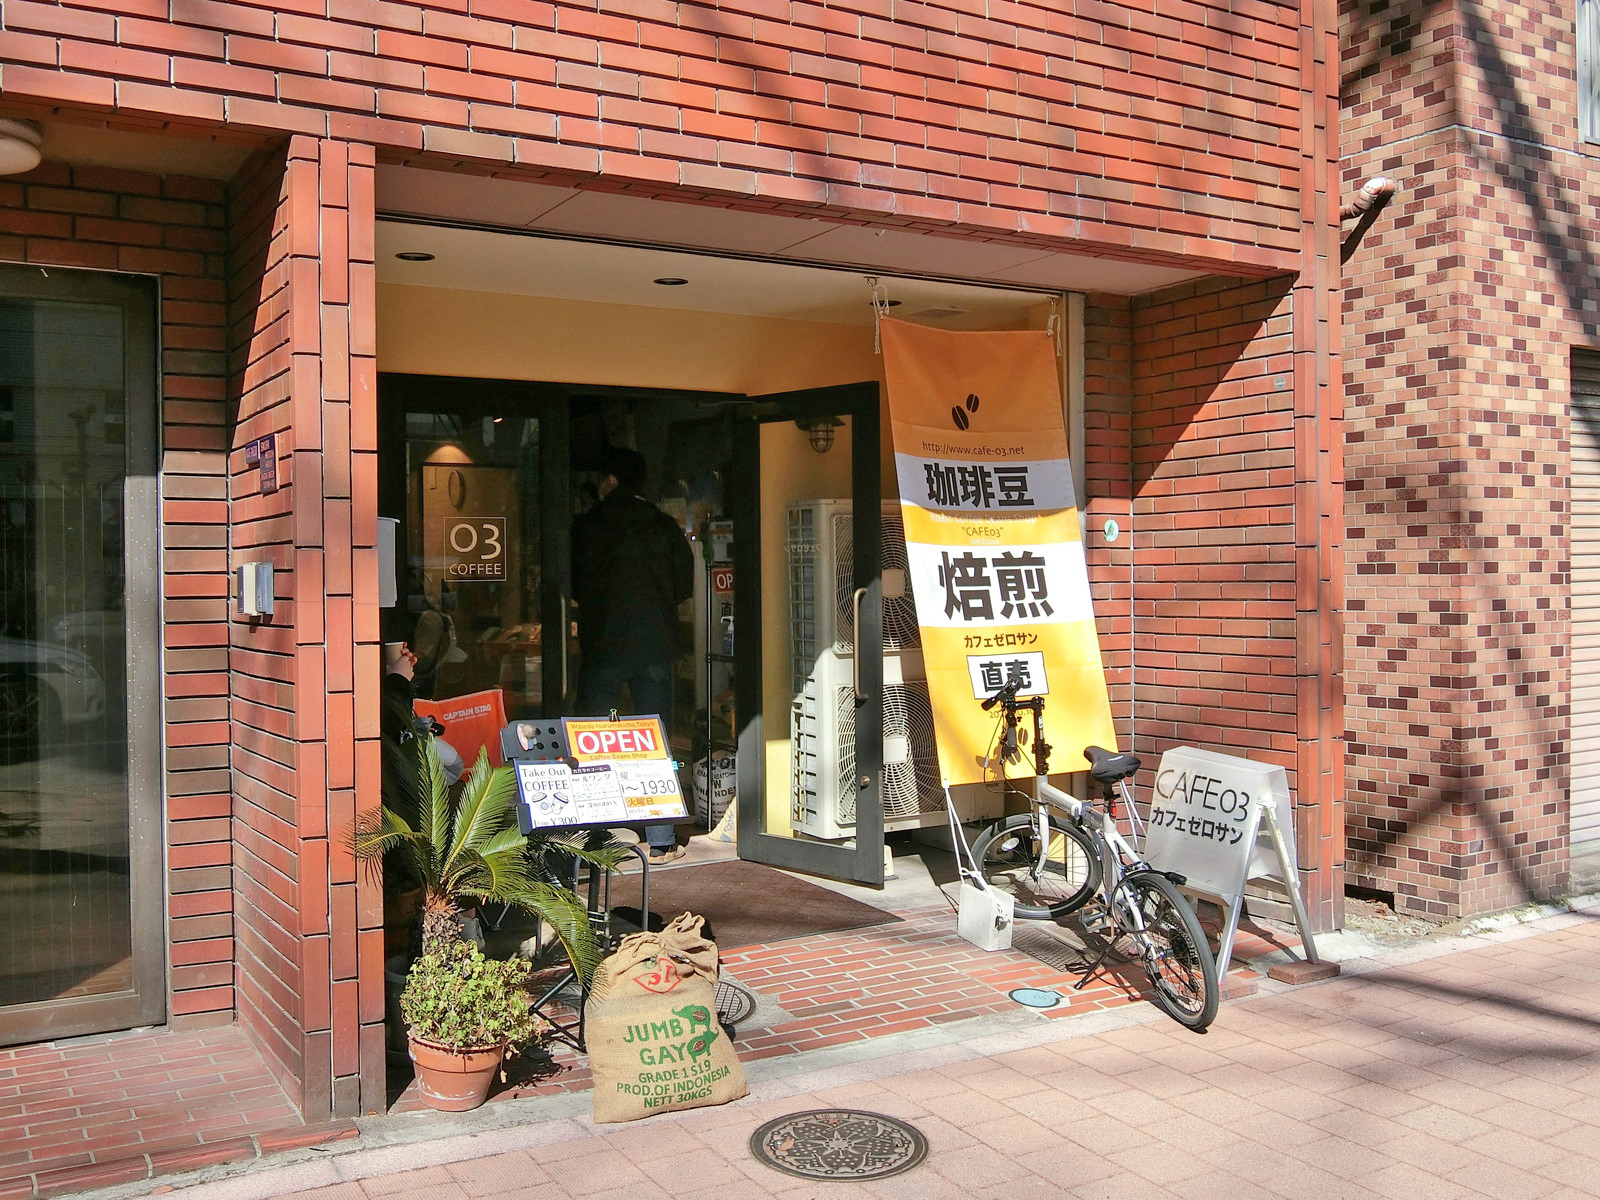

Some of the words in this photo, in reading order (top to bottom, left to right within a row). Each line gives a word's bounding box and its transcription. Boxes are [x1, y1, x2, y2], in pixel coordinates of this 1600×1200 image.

[922, 441, 1025, 457] http://www.cafe-03.net
[923, 462, 1035, 509] 珈琲豆
[929, 511, 952, 522] Roast
[954, 513, 982, 523] Coffee
[985, 514, 1012, 524] Beans
[1013, 513, 1038, 525] Shop
[449, 563, 502, 575] COFFEE
[716, 573, 733, 589] OP
[938, 551, 1055, 621] 焙煎
[963, 631, 1038, 649] カフェゼロサン
[979, 659, 1032, 694] 直売
[443, 708, 474, 721] CAPTAIN
[474, 703, 492, 714] STAG
[577, 729, 655, 754] OPEN
[521, 768, 546, 778] Take
[548, 767, 566, 776] Out
[524, 779, 570, 791] COFFEE
[1156, 768, 1250, 822] CAFE03
[1151, 806, 1244, 845] カフェゼロサン
[638, 1067, 679, 1083] GRADE
[683, 1067, 689, 1079] 1
[673, 1065, 731, 1094] INDONESIA
[643, 1094, 673, 1109] NETT
[676, 1085, 713, 1104] 30KGS
